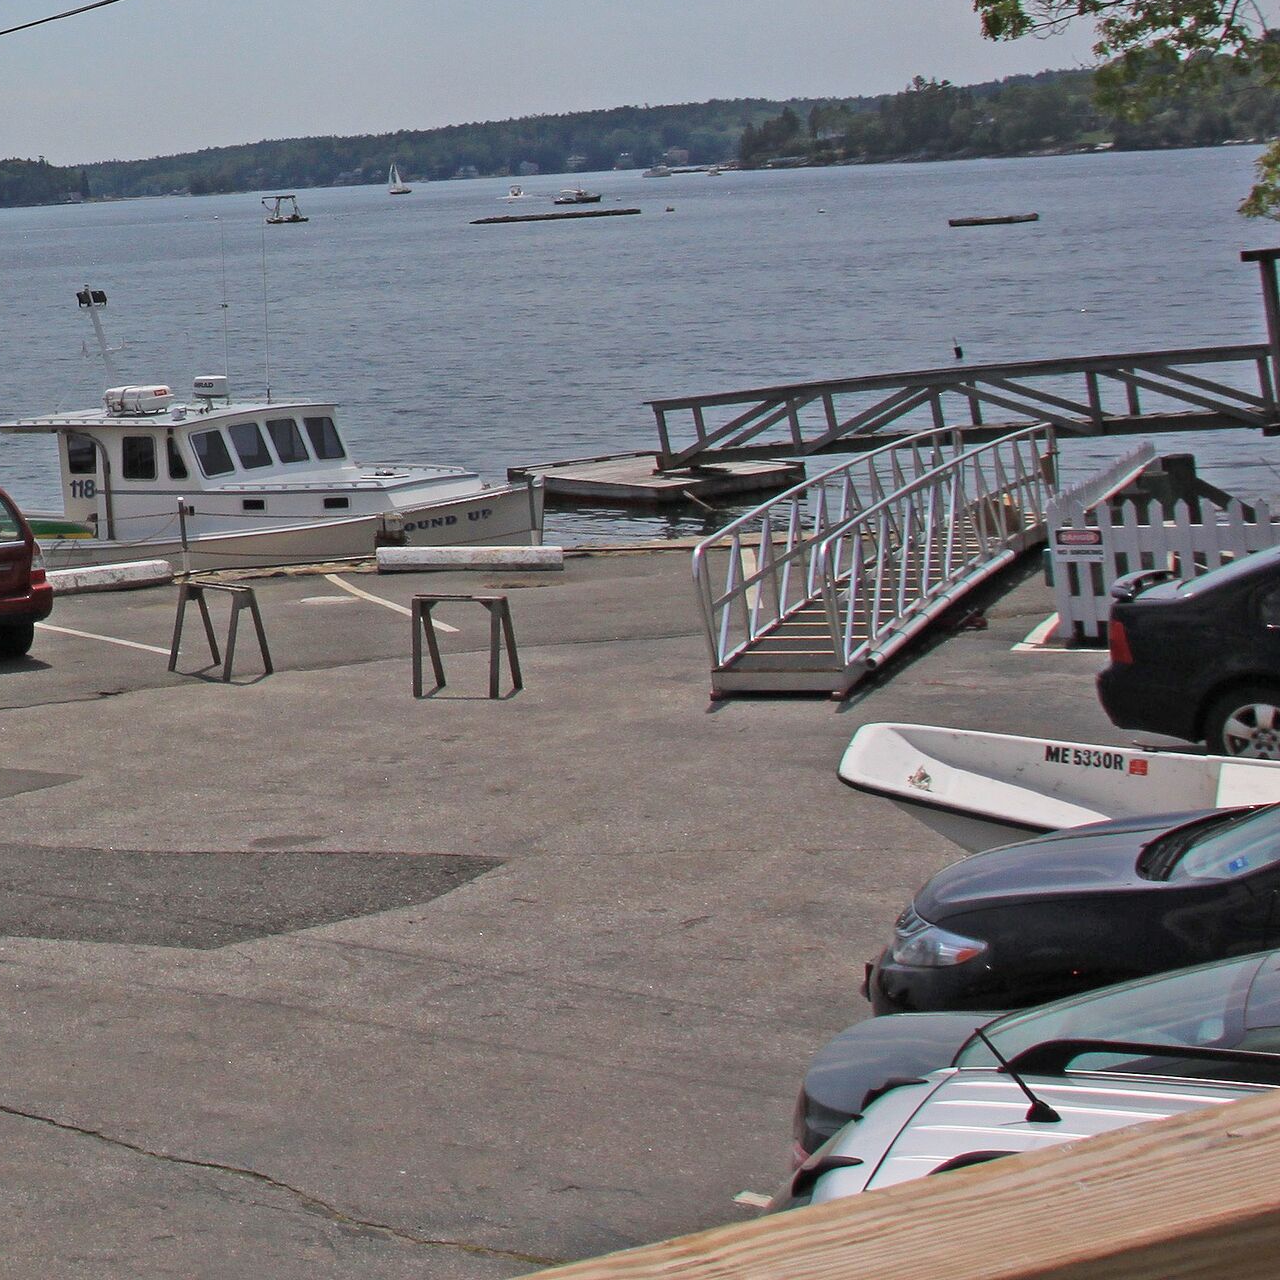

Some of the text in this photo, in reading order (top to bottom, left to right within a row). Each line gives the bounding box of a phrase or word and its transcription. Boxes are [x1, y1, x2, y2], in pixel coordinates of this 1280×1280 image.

[70, 480, 95, 498] 118
[403, 508, 493, 532] OUND UP
[1044, 745, 1070, 764] ME
[1073, 748, 1124, 771] 5330R
